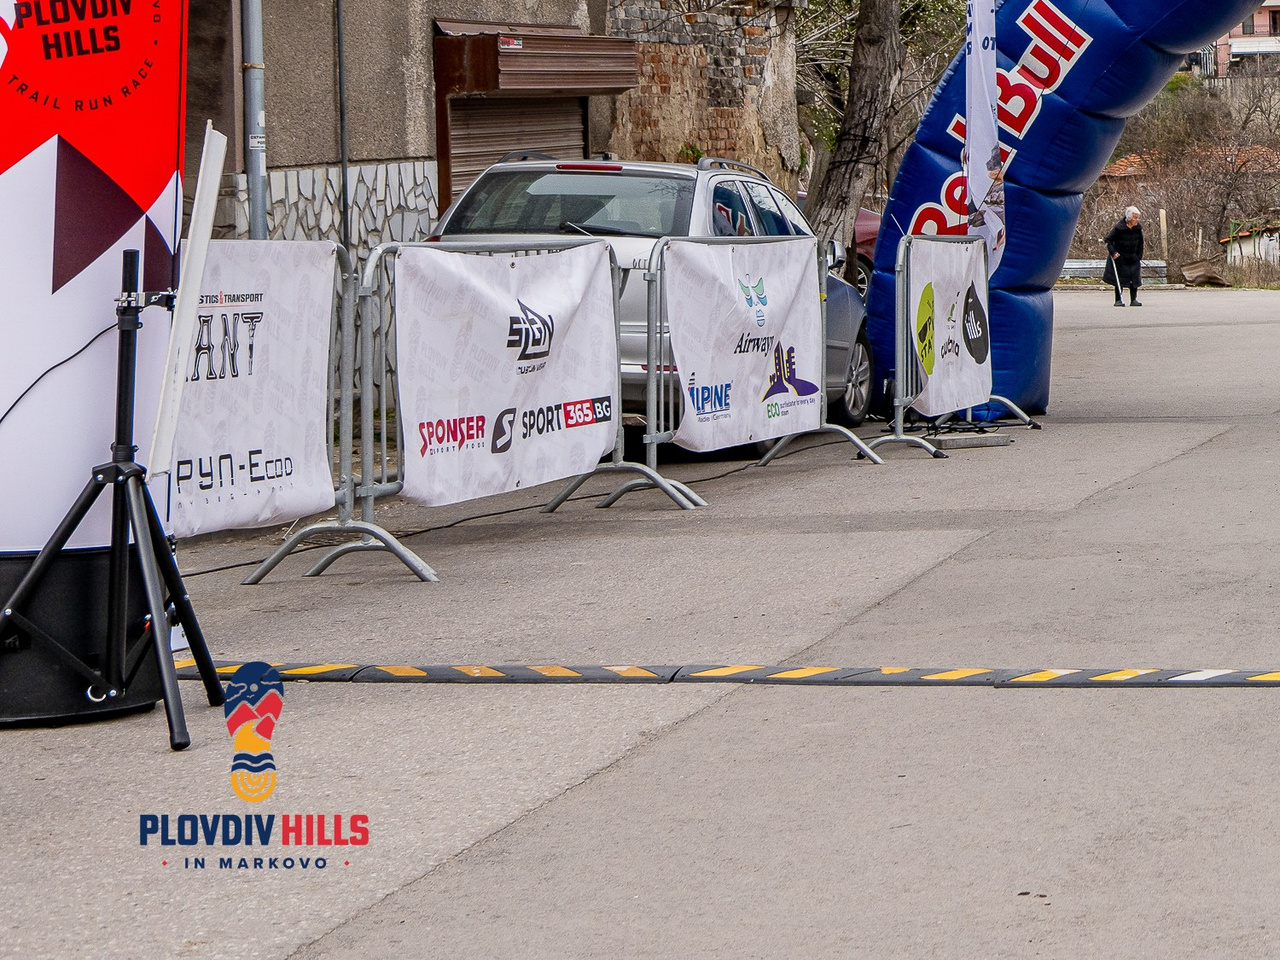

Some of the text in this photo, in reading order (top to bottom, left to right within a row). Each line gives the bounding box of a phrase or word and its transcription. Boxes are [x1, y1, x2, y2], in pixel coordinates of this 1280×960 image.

[41, 25, 120, 60] HILLS
[7, 58, 153, 111] TRAIL RUN RACE
[199, 294, 219, 304] STICS
[224, 293, 263, 303] TRANSPORT
[190, 312, 264, 382] ANT
[766, 402, 780, 419] ECO
[418, 415, 486, 457] SPONSER
